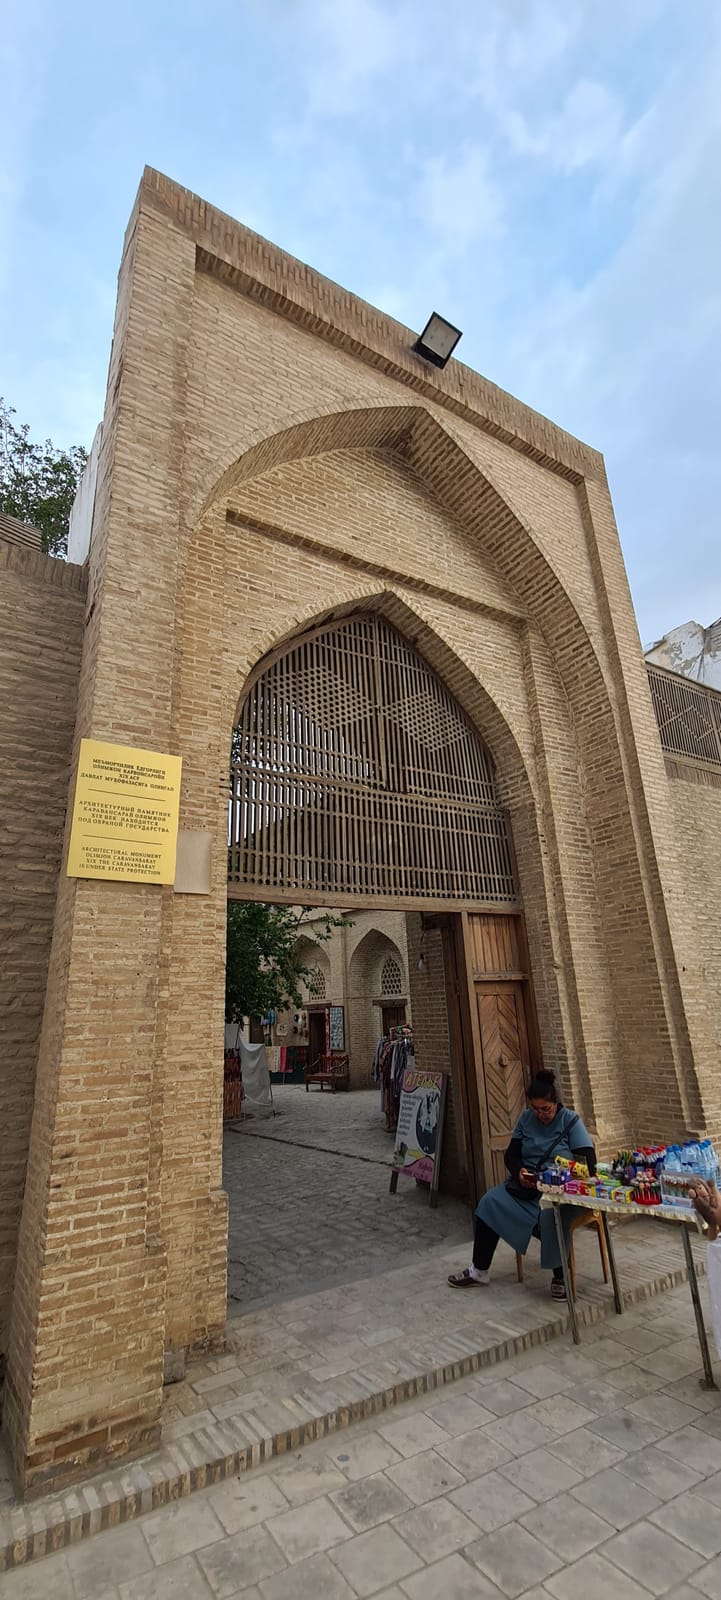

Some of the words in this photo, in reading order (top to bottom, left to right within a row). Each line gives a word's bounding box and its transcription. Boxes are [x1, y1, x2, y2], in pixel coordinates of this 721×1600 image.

[80, 772, 103, 780] ДАВЛАТ
[79, 800, 135, 812] АРХИТЕКТУРНЫЙ
[137, 808, 171, 818] ПАМЯТНИК
[120, 816, 159, 826] НАХОДИТСЯ
[135, 813, 166, 822] ОЛИМЖОН
[93, 818, 123, 827] ОХРАНОЙ
[125, 823, 170, 833] ГОСУДАРСТВА
[81, 846, 128, 856] ARCHITECTURAL
[130, 851, 162, 859] MONUMENT
[85, 852, 111, 860] OLIMJON
[113, 855, 156, 864] CARAVANSARAY
[112, 860, 155, 869] CARAVANSARAY
[127, 868, 161, 876] PROTECTION
